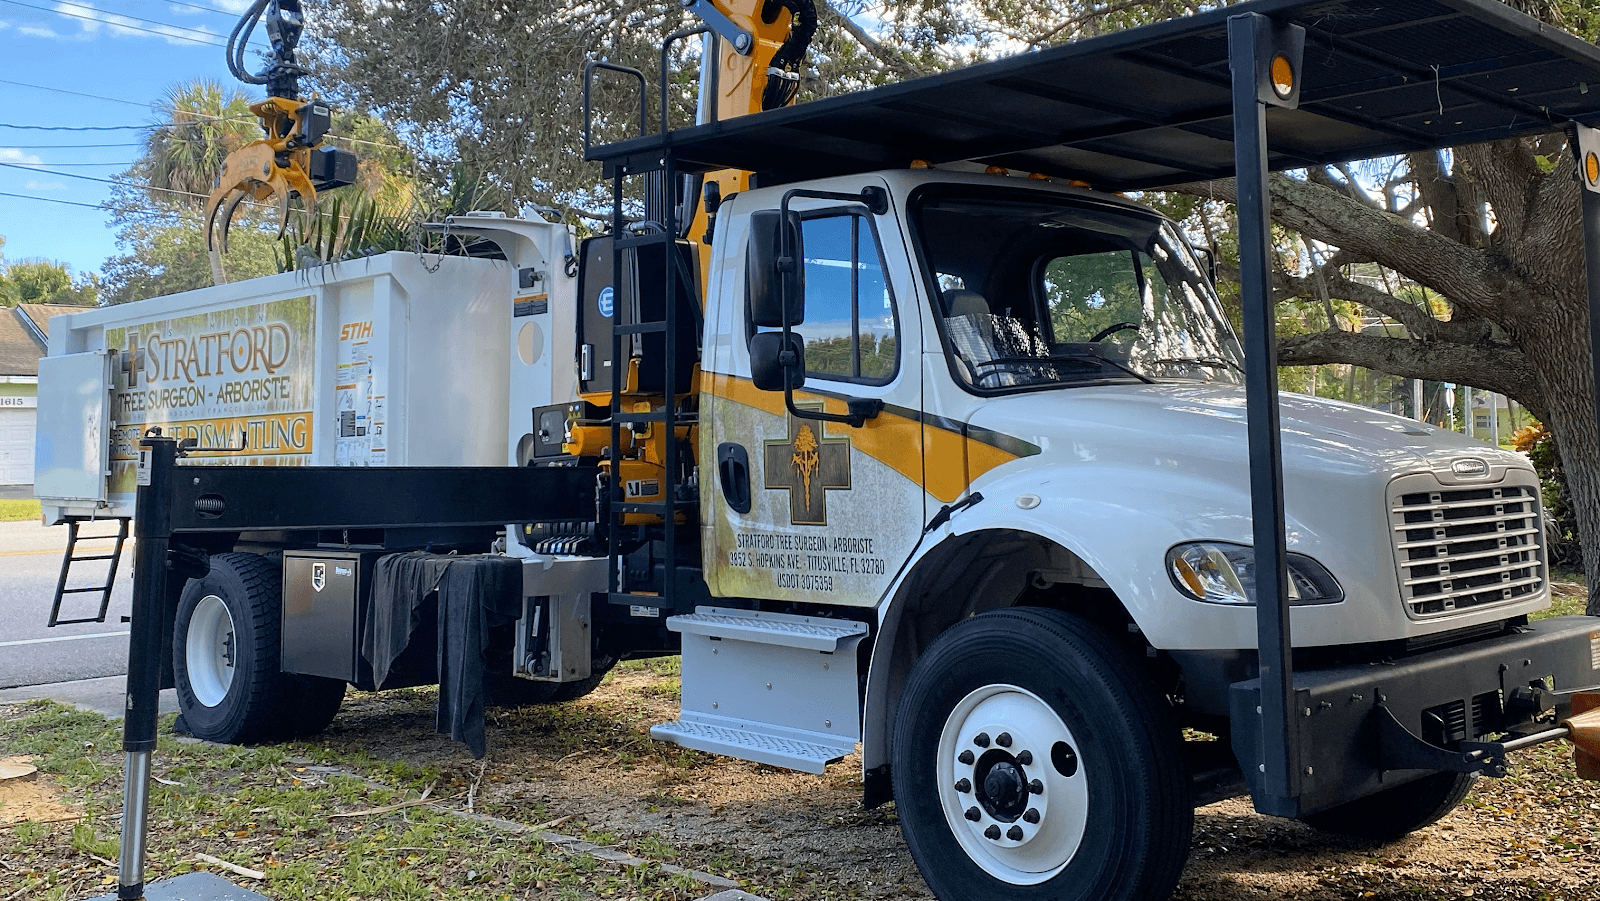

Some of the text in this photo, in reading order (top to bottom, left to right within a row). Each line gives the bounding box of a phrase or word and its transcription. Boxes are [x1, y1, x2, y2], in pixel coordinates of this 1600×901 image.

[145, 322, 290, 383] STRATFORD
[0, 398, 23, 406] 1615
[118, 391, 146, 412] TREE
[148, 385, 205, 410] SURGEON
[216, 376, 290, 405] ARBORISTE
[186, 417, 307, 452] DISMANTLING
[737, 533, 775, 549] STRATFORD
[776, 534, 792, 550] TREE
[794, 535, 827, 551] SURGEON
[833, 537, 873, 554] ARBORISTE
[730, 552, 746, 567] 3852
[748, 552, 754, 567] S.
[756, 553, 785, 569] HOPKINS
[787, 554, 801, 570] AVE.
[807, 555, 849, 575] TITUSVILLE,
[851, 558, 859, 573] FL
[861, 558, 885, 575] 32780
[778, 573, 833, 591] USDOT 3075359
